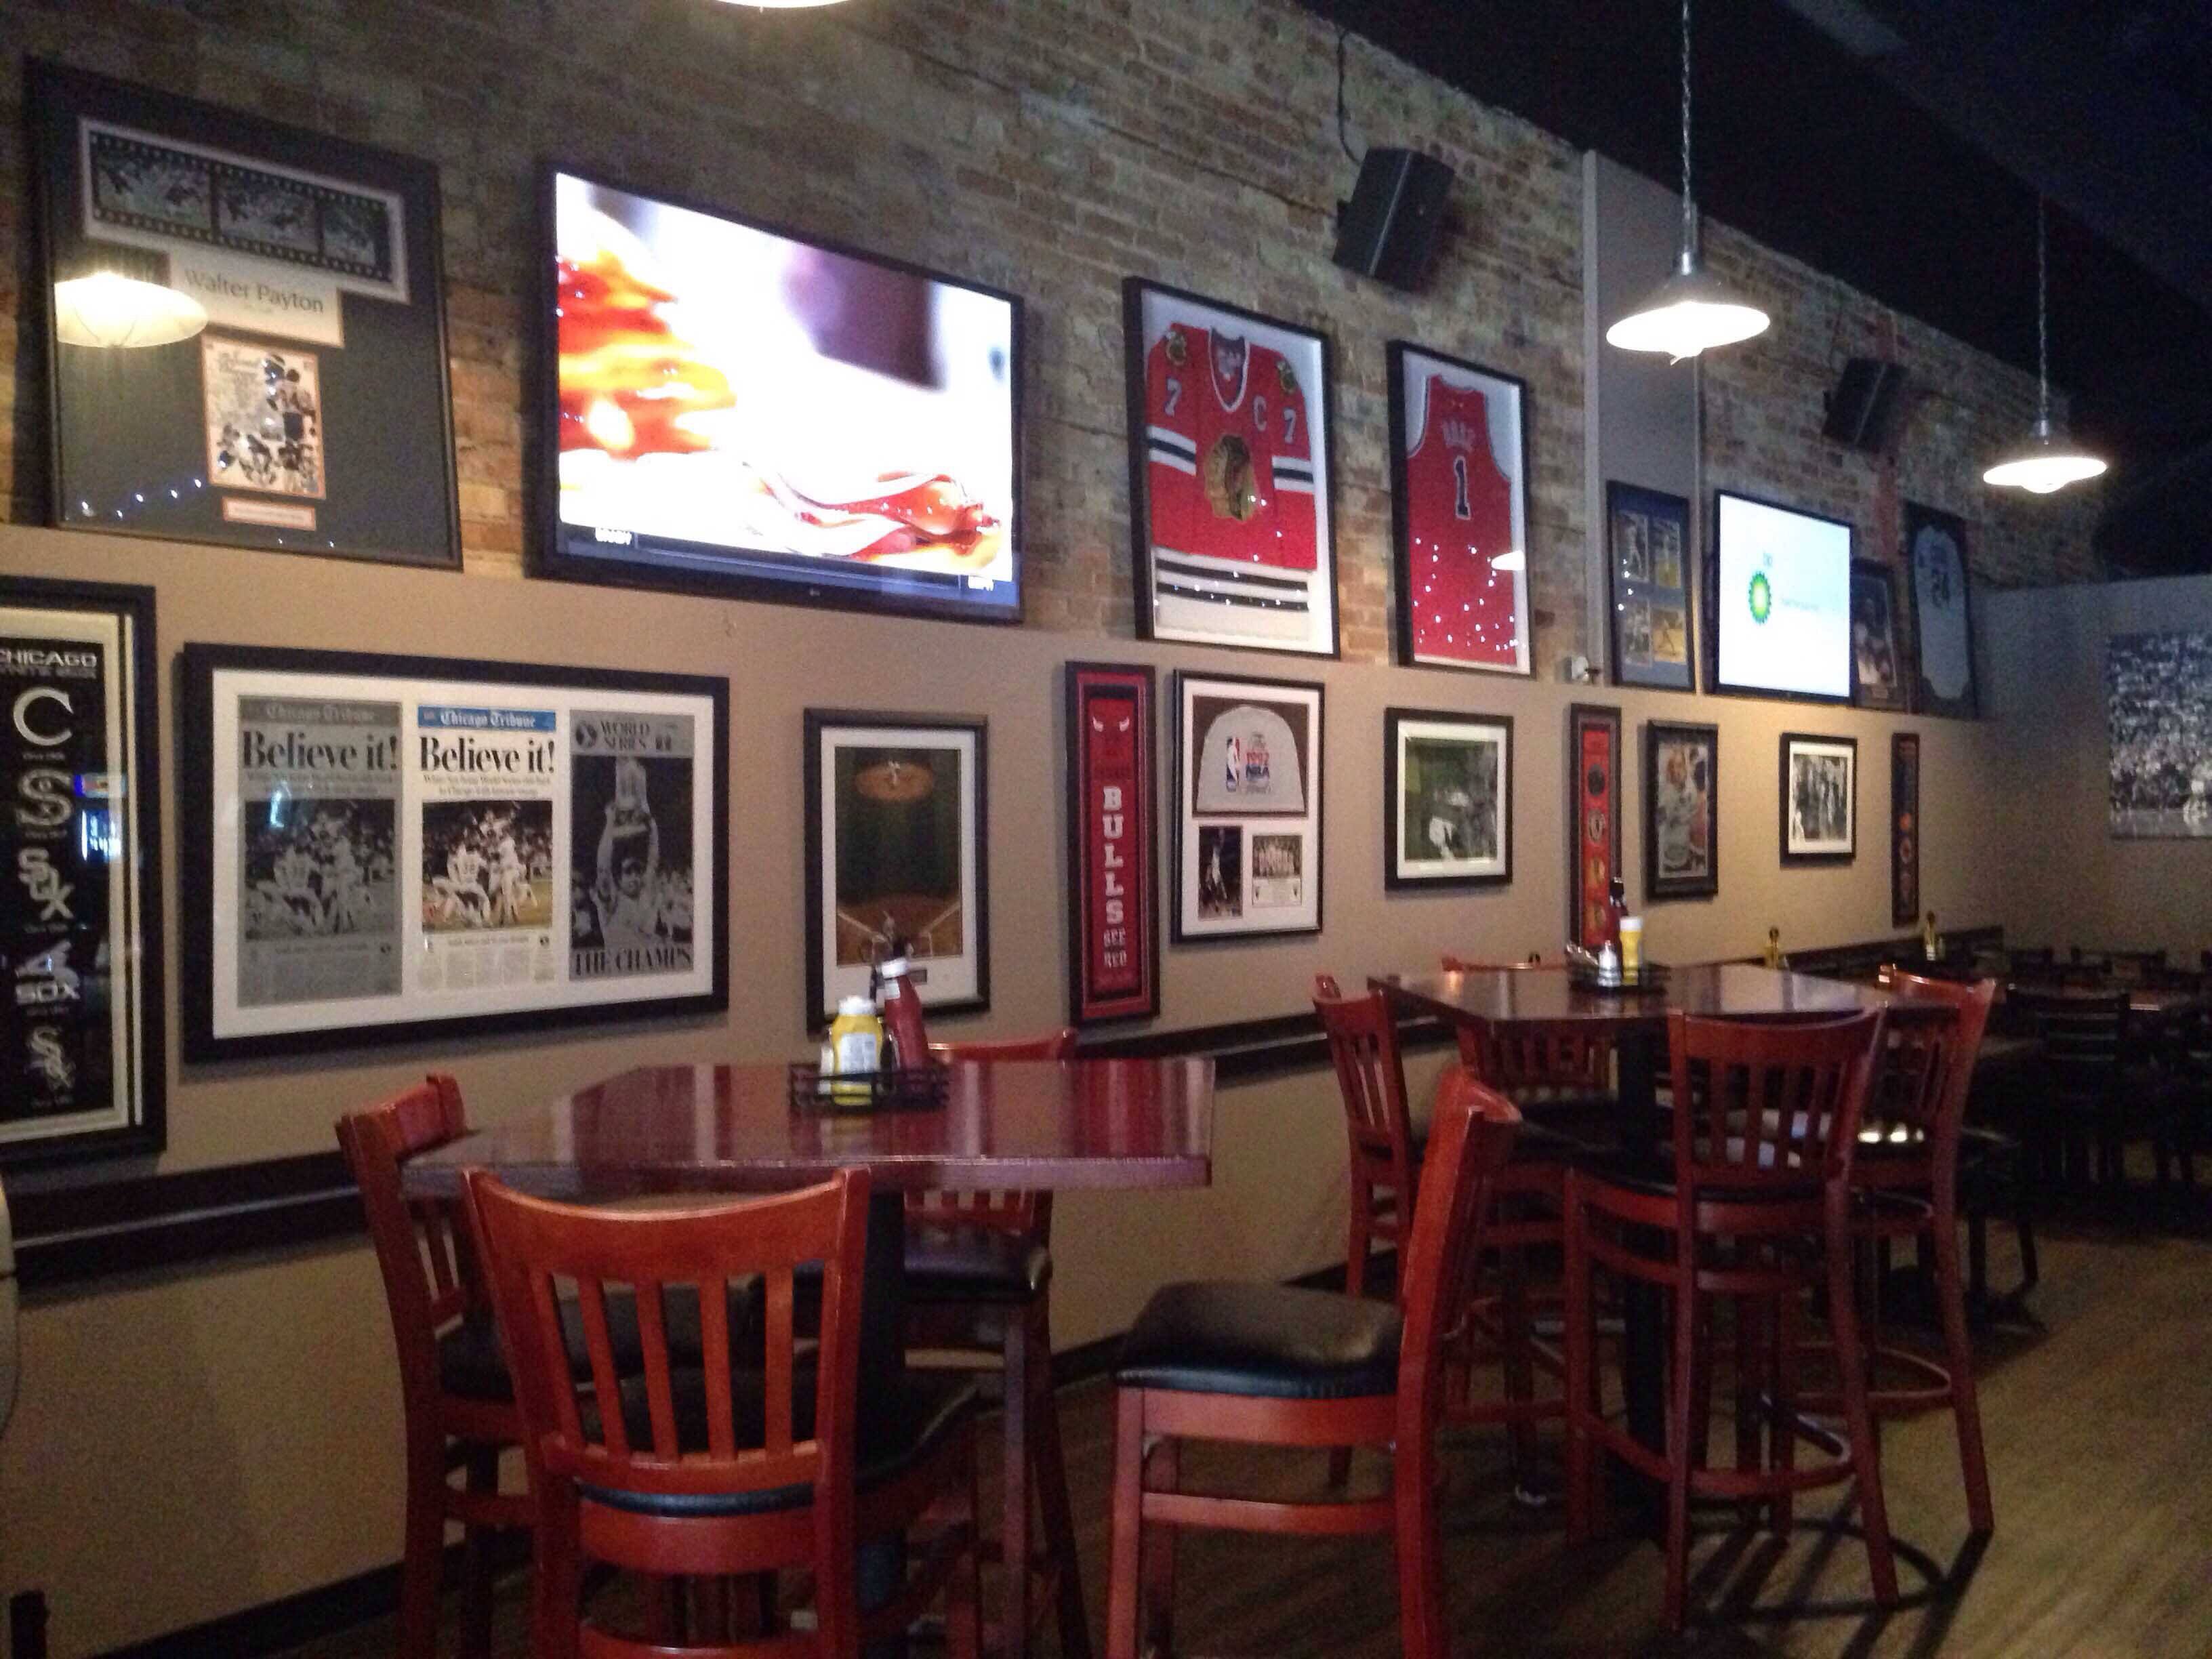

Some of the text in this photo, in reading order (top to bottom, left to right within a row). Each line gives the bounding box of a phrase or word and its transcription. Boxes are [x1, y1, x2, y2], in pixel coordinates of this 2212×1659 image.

[257, 282, 325, 314] Payton
[1453, 455, 1472, 521] 1
[441, 710, 488, 728] Chicago
[491, 711, 535, 729] Tribune
[243, 731, 397, 771] Believe it!
[419, 736, 555, 774] Believe it!
[1102, 785, 1124, 924] BULLS
